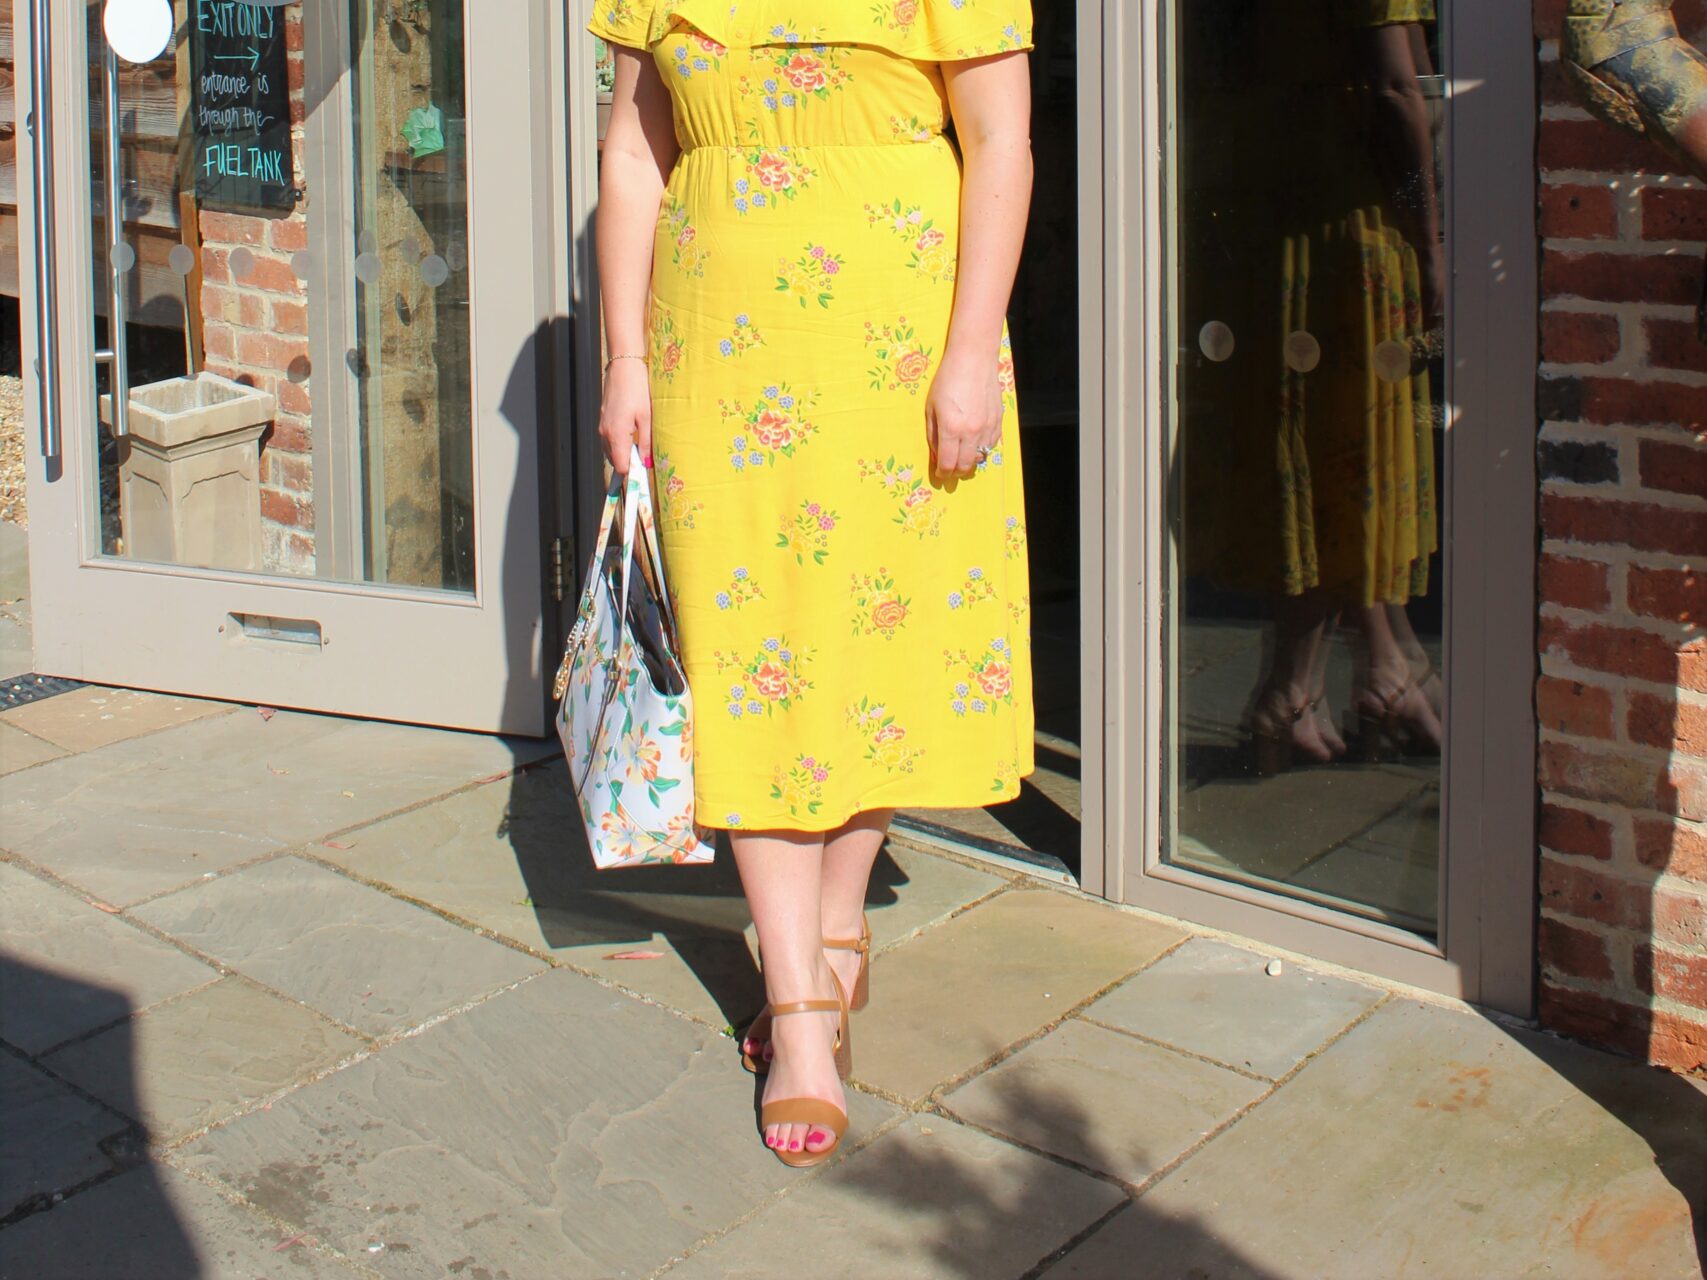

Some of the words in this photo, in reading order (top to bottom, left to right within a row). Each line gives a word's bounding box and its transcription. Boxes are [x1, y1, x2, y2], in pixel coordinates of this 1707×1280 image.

[237, 3, 274, 39] ONLY
[201, 72, 251, 102] entrance
[257, 73, 270, 95] is
[199, 104, 240, 137] through
[243, 106, 275, 136] the
[203, 142, 249, 177] FUEL
[247, 146, 285, 187] TANK
